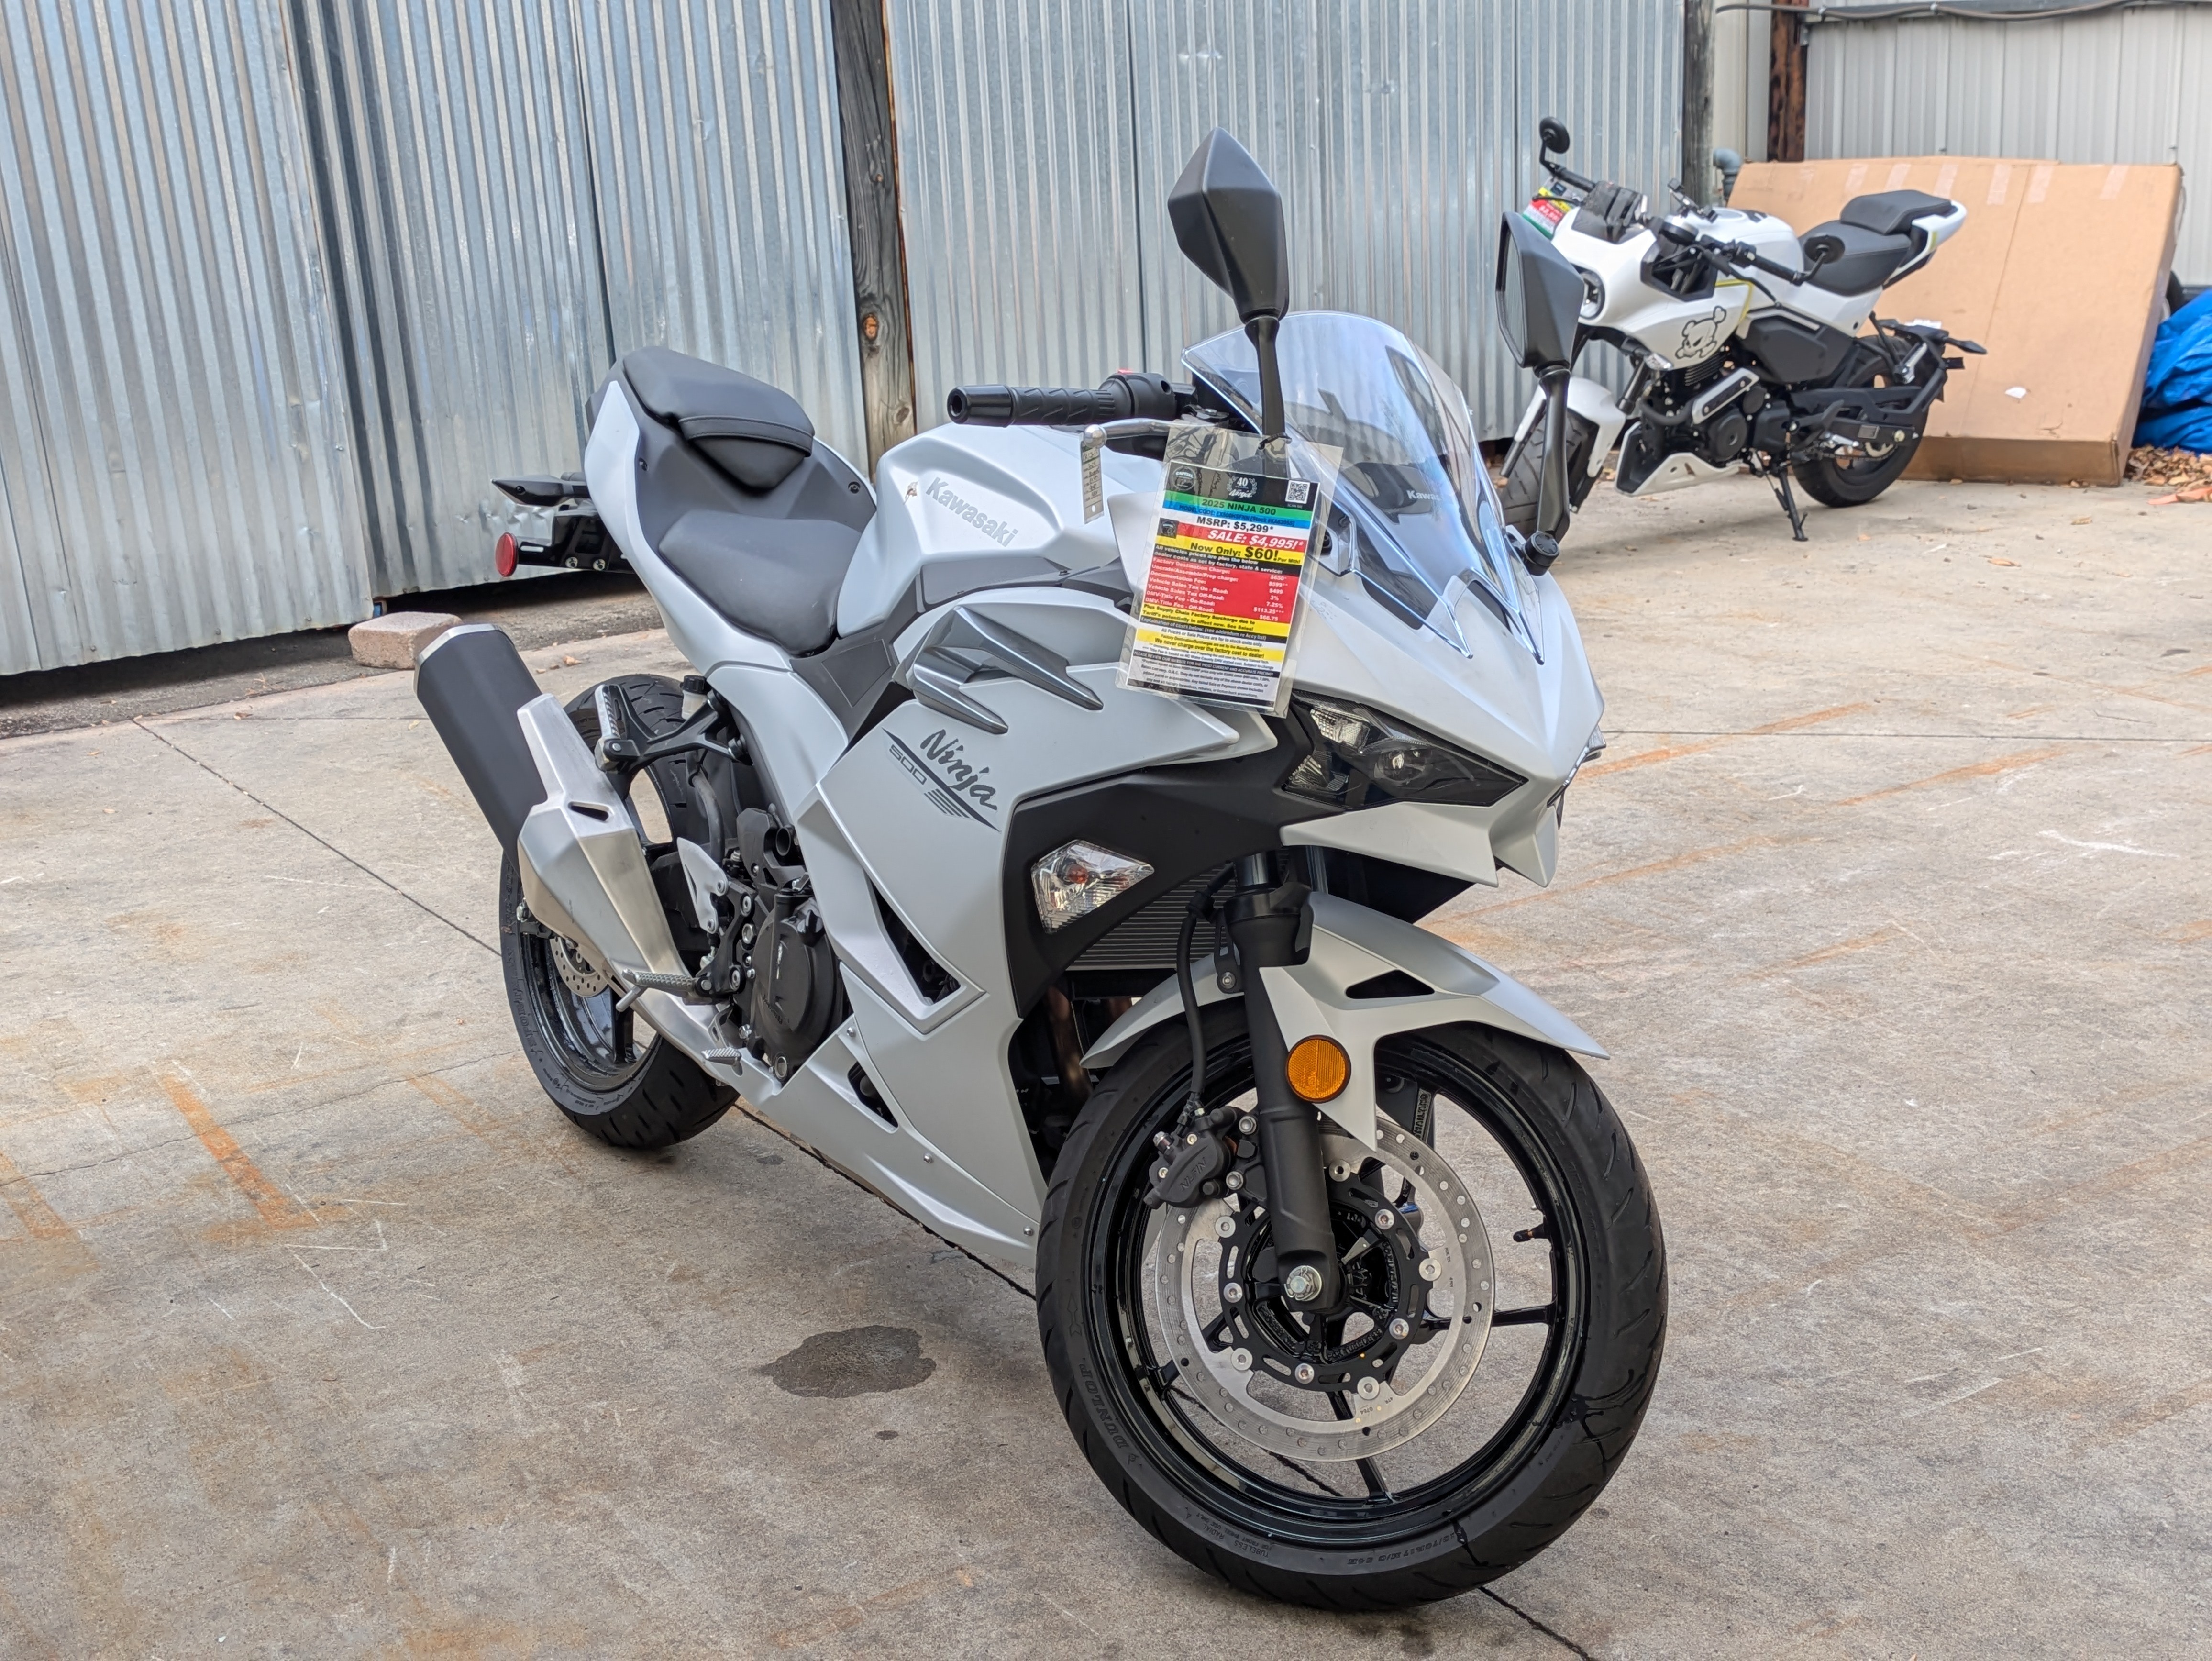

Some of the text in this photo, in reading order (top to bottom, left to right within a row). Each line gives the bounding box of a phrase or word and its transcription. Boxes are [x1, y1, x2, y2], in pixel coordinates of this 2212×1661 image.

[1236, 477, 1248, 486] 40
[1228, 489, 1253, 500] Ninja
[926, 477, 1018, 547] Kawasaki
[1202, 499, 1276, 515] 2025 NINJA 500
[1196, 516, 1230, 528] MSRP:
[1208, 529, 1246, 543] SALE:
[1190, 543, 1213, 552] Now
[1216, 546, 1241, 557] Only:
[1244, 546, 1279, 561] $60!
[1175, 561, 1207, 570] Destination
[1150, 571, 1193, 582] Documentation
[888, 744, 927, 785] 500
[920, 729, 998, 811] Ninja
[1078, 1363, 1128, 1449] DUNLOP
[1201, 1524, 1269, 1558] TUBELESS RADIAL
